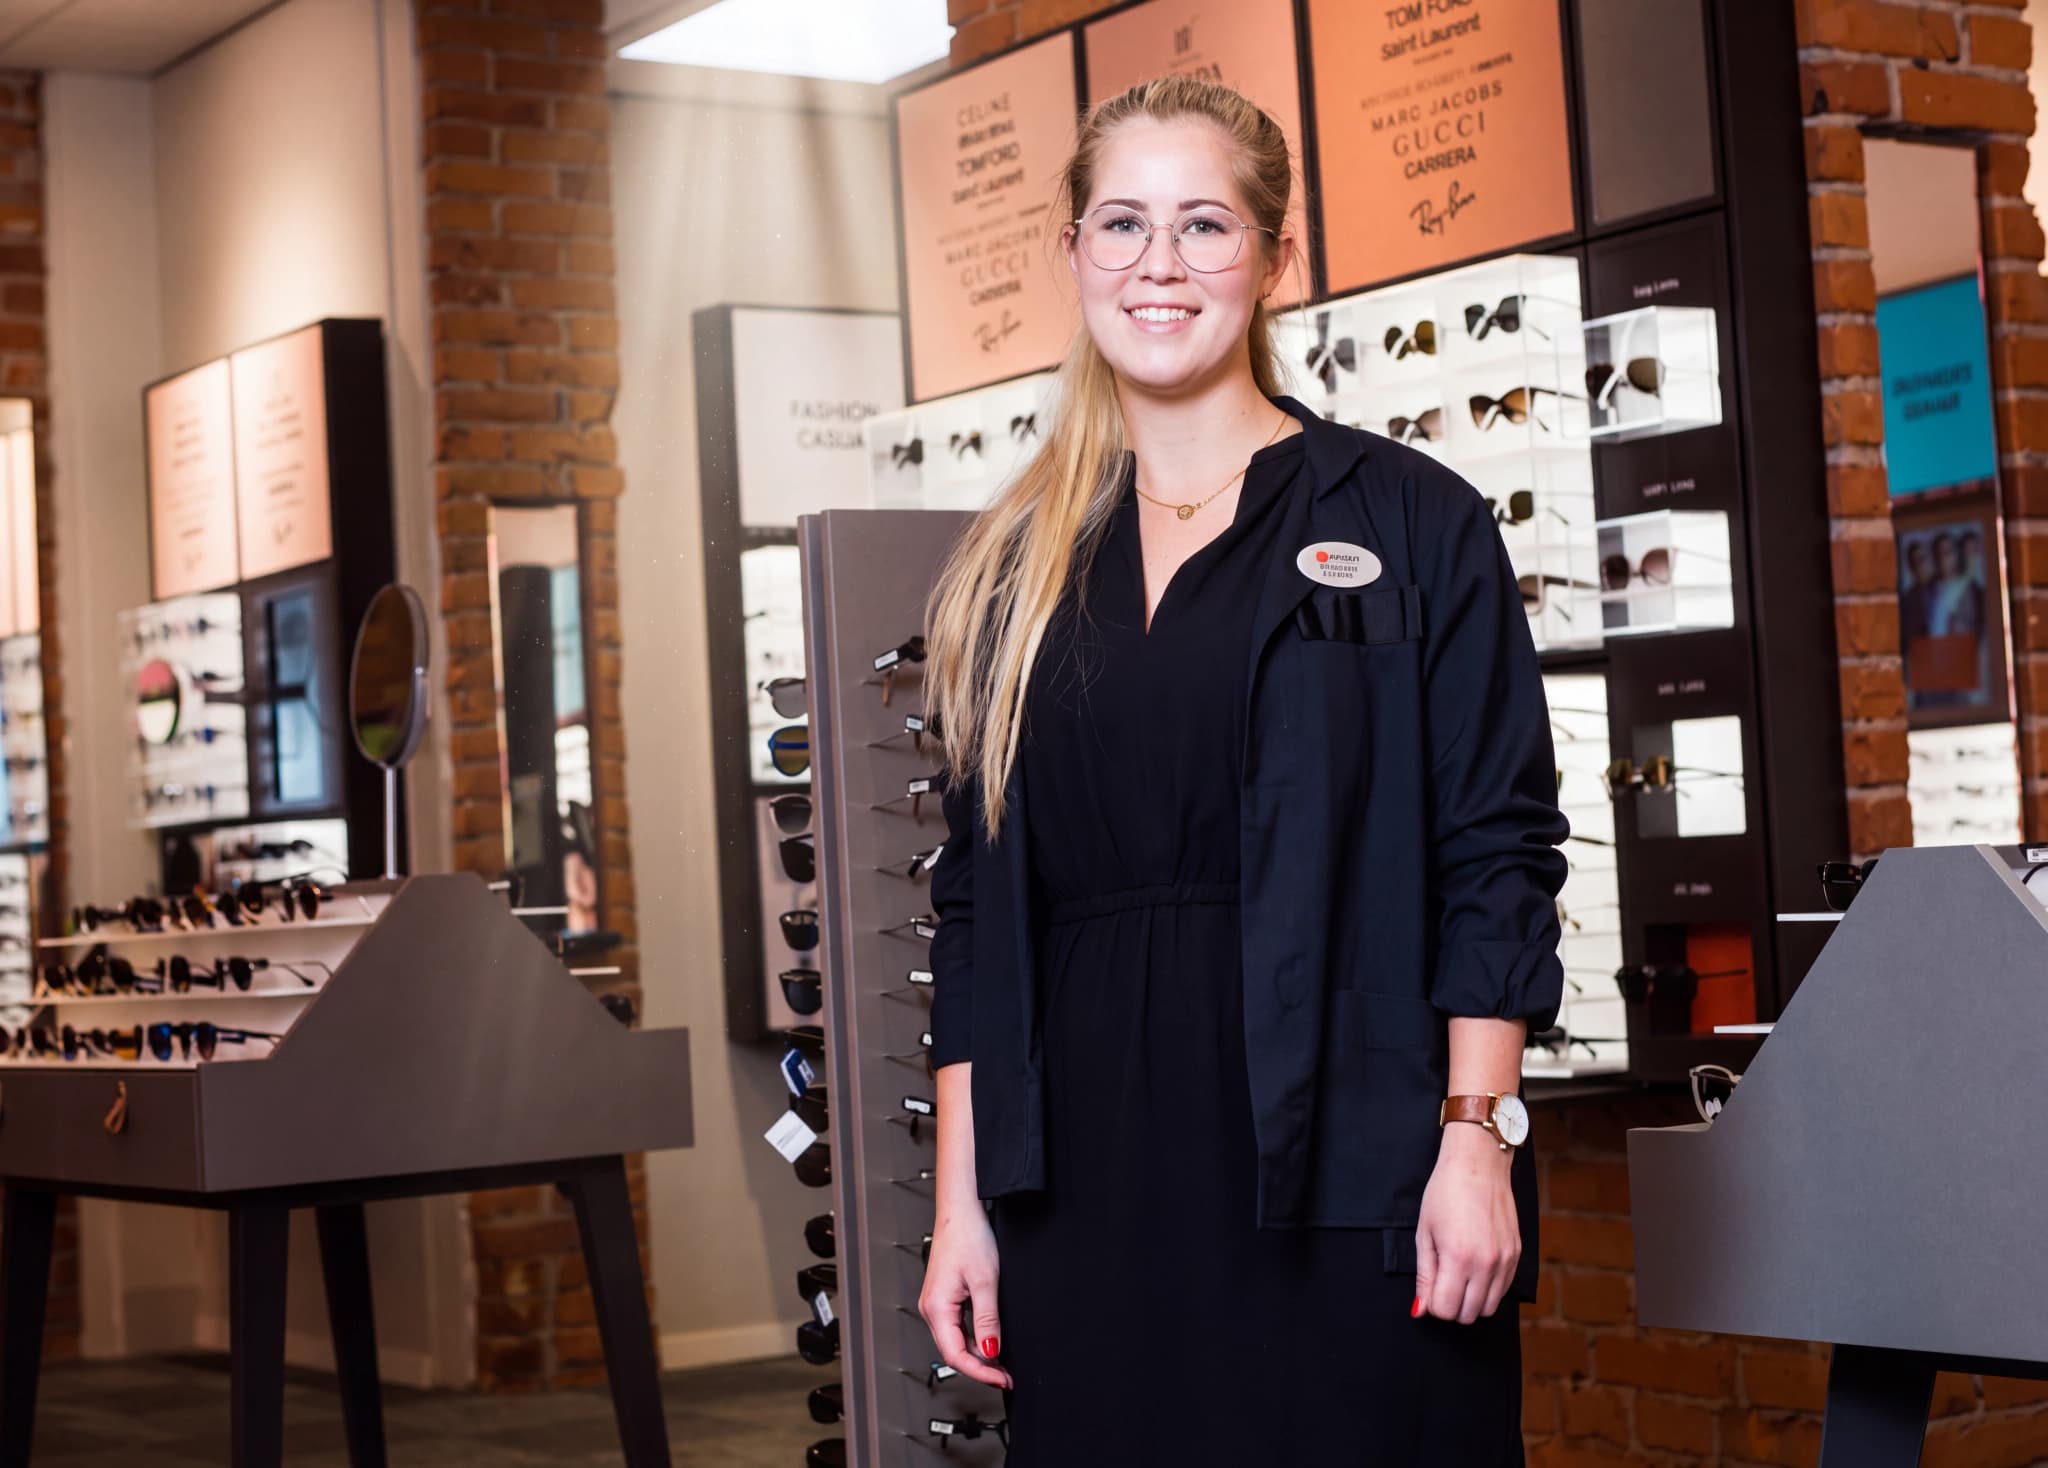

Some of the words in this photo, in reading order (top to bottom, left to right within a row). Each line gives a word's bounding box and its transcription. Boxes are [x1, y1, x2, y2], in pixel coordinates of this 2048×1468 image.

[1385, 1, 1422, 30] TOM
[1382, 34, 1416, 60] Saint
[1421, 13, 1480, 47] Laurent
[1371, 104, 1421, 132] MARC
[1429, 79, 1503, 116] JACOBS
[1393, 111, 1484, 156] GUCCI
[1403, 145, 1477, 180] CARRERA
[960, 250, 1029, 289] GUCCI
[796, 427, 864, 450] CASUA
